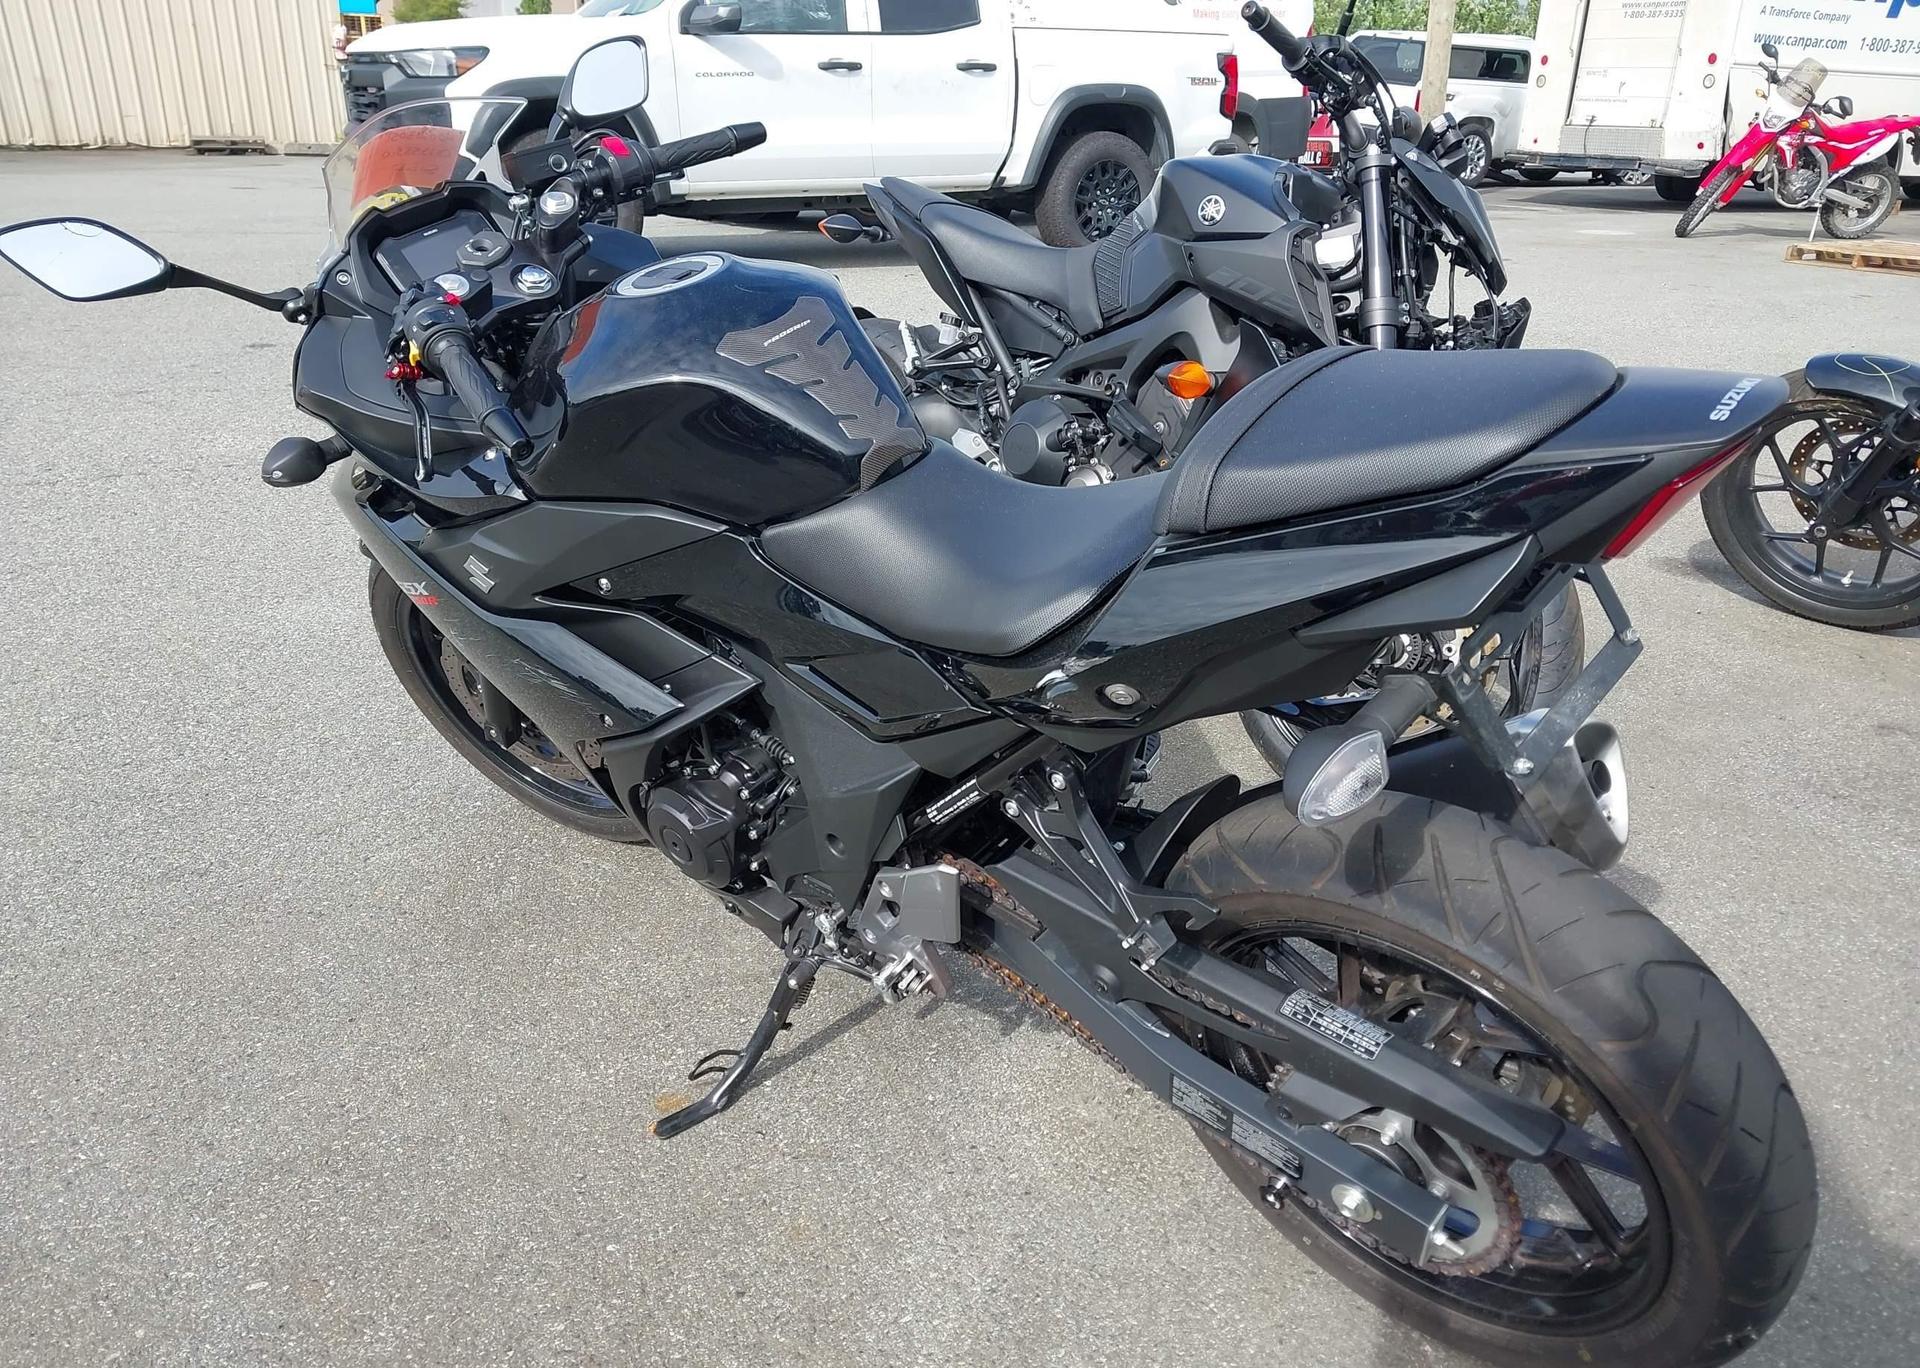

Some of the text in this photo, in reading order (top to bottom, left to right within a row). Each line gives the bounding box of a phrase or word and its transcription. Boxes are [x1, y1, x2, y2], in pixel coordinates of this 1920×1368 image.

[1622, 0, 1686, 9] www.canpar.com
[1623, 9, 1685, 19] 1-800-387-9335
[1760, 5, 1851, 24] A TransForce Company
[1753, 32, 1848, 51] www.canpar.com
[1709, 378, 1761, 421] SUZUKI
